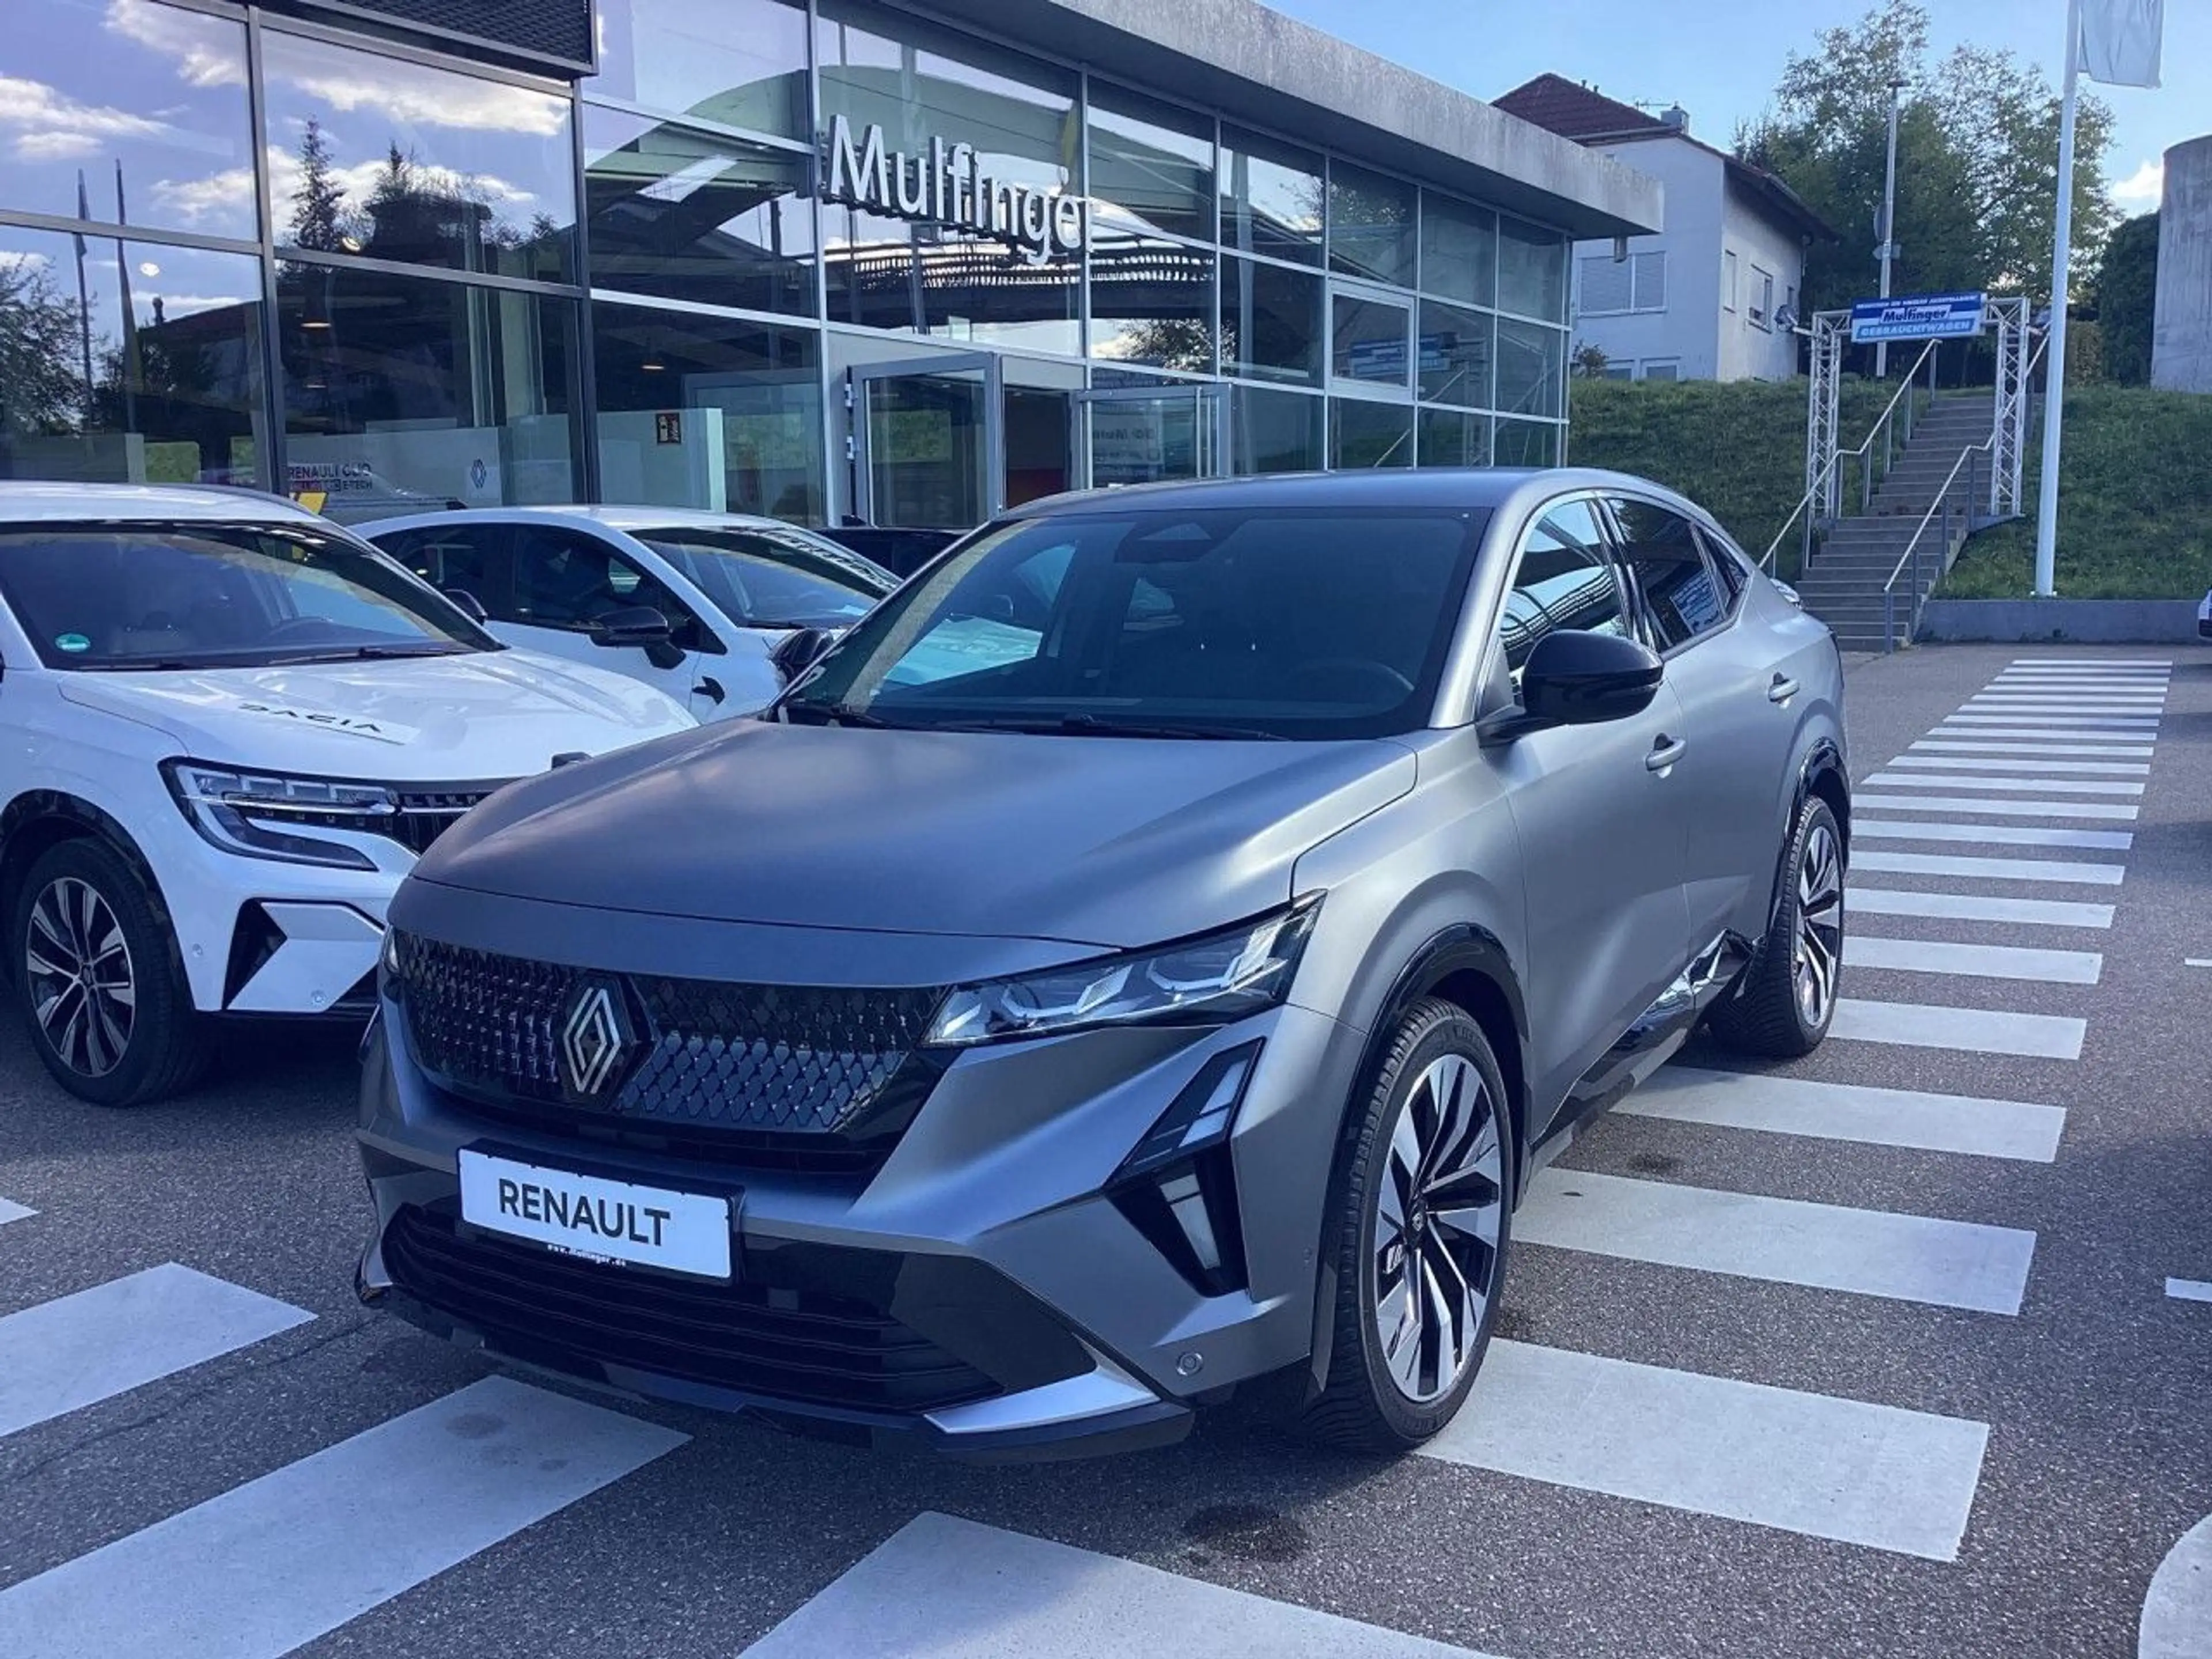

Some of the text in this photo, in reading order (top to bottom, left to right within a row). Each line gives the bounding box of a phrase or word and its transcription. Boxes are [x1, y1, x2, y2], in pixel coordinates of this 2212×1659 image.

[1882, 307, 1946, 323] Mulfinger
[1861, 321, 1970, 336] GEBRAUCHTWAGEN
[237, 703, 381, 733] DACIA
[499, 1178, 671, 1247] RENAULT
